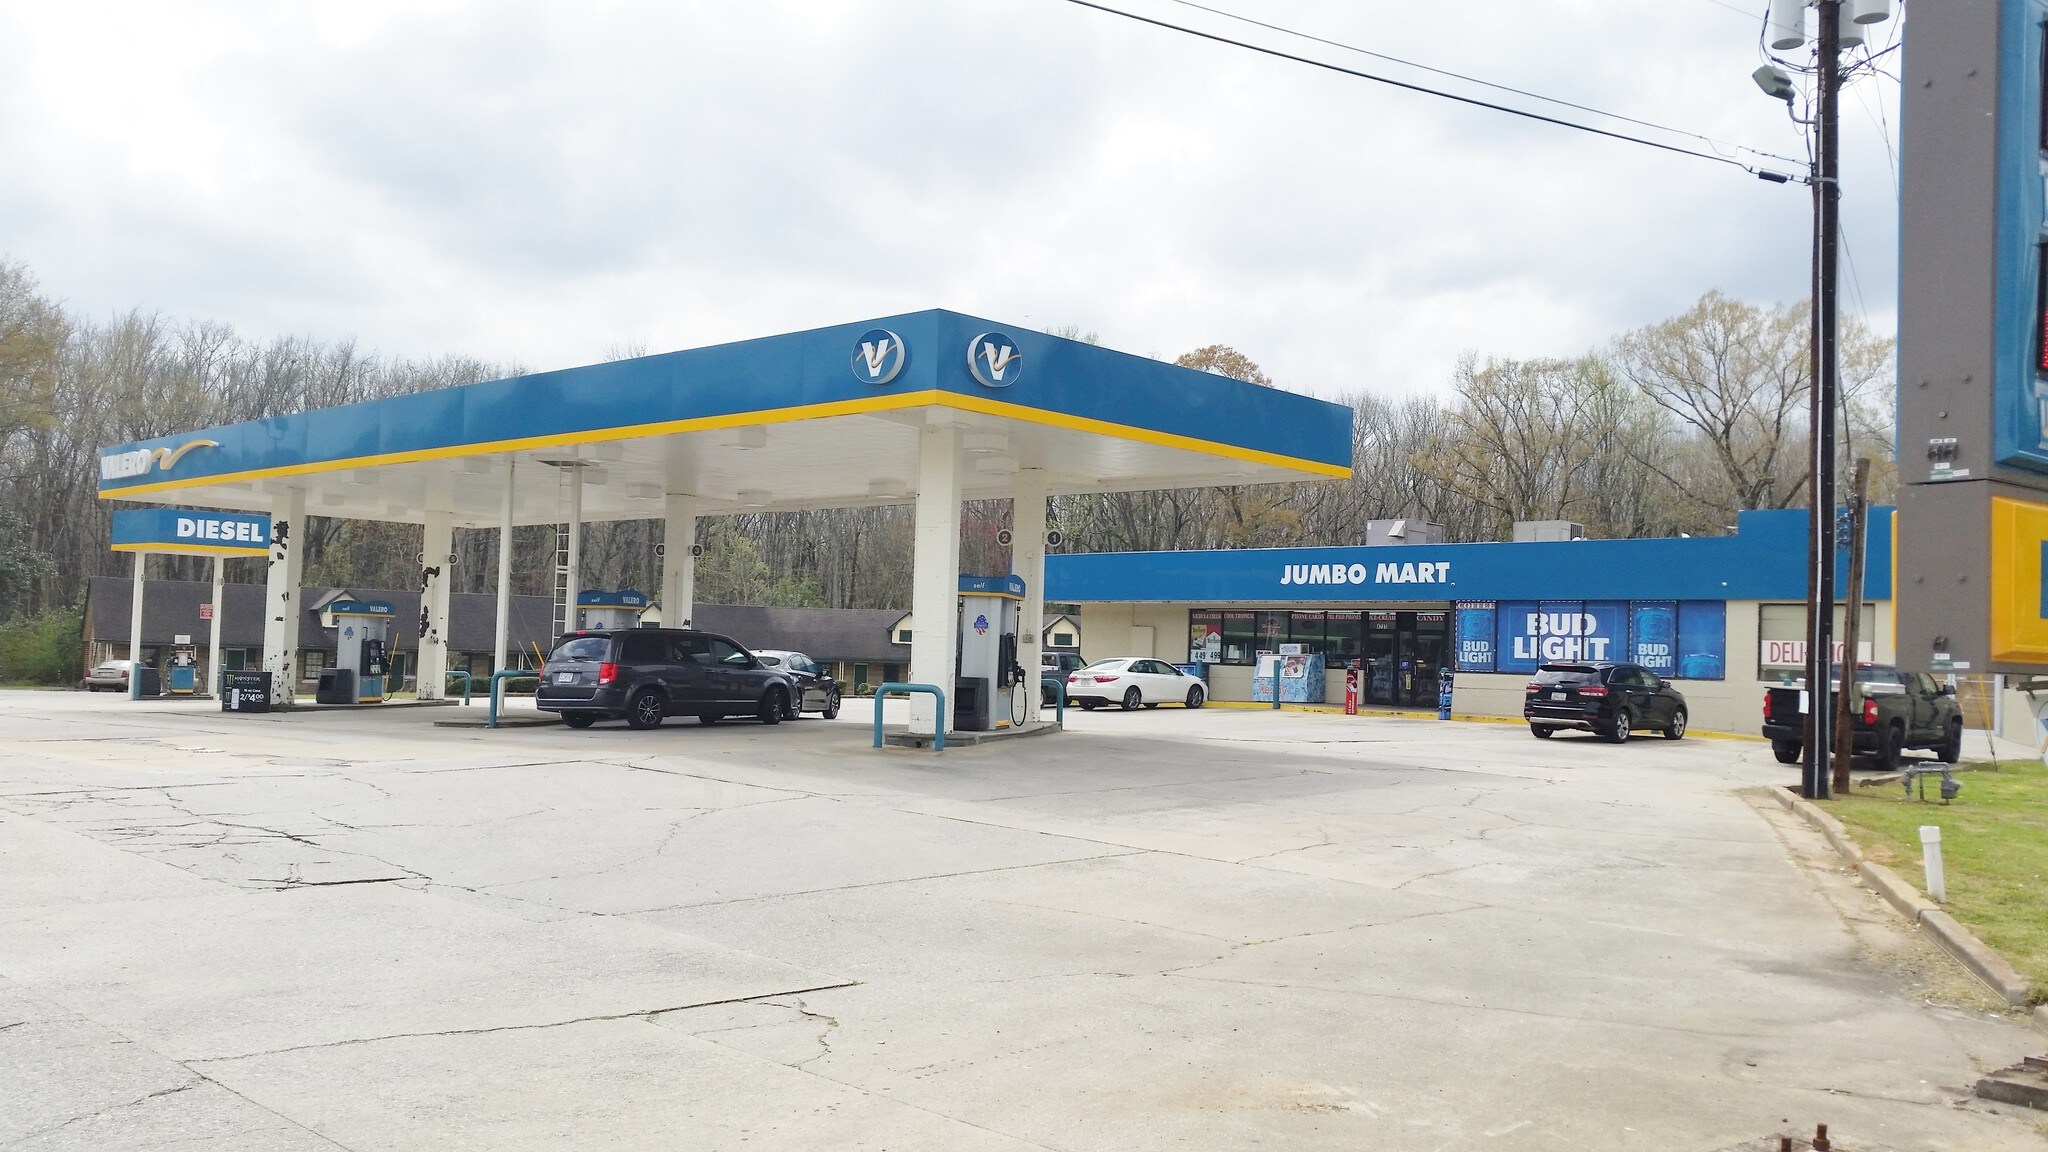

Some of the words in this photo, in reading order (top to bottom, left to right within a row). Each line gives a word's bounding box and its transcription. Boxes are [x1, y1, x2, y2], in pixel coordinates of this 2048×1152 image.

[861, 339, 889, 377] V
[983, 342, 1012, 380] V
[101, 449, 152, 480] VALERO
[177, 518, 263, 543] DIESEL
[1280, 563, 1367, 585] JUMBO
[1375, 562, 1450, 584] MART
[622, 596, 640, 604] VALERO
[1527, 613, 1597, 636] BUD
[1195, 651, 1206, 659] 449
[1210, 651, 1220, 659] 499
[1463, 641, 1489, 652] BUD
[1514, 636, 1610, 661] LIGHT
[1638, 644, 1669, 656] BUD
[1460, 652, 1492, 663] LIGHT
[1634, 655, 1672, 668] LIGHT
